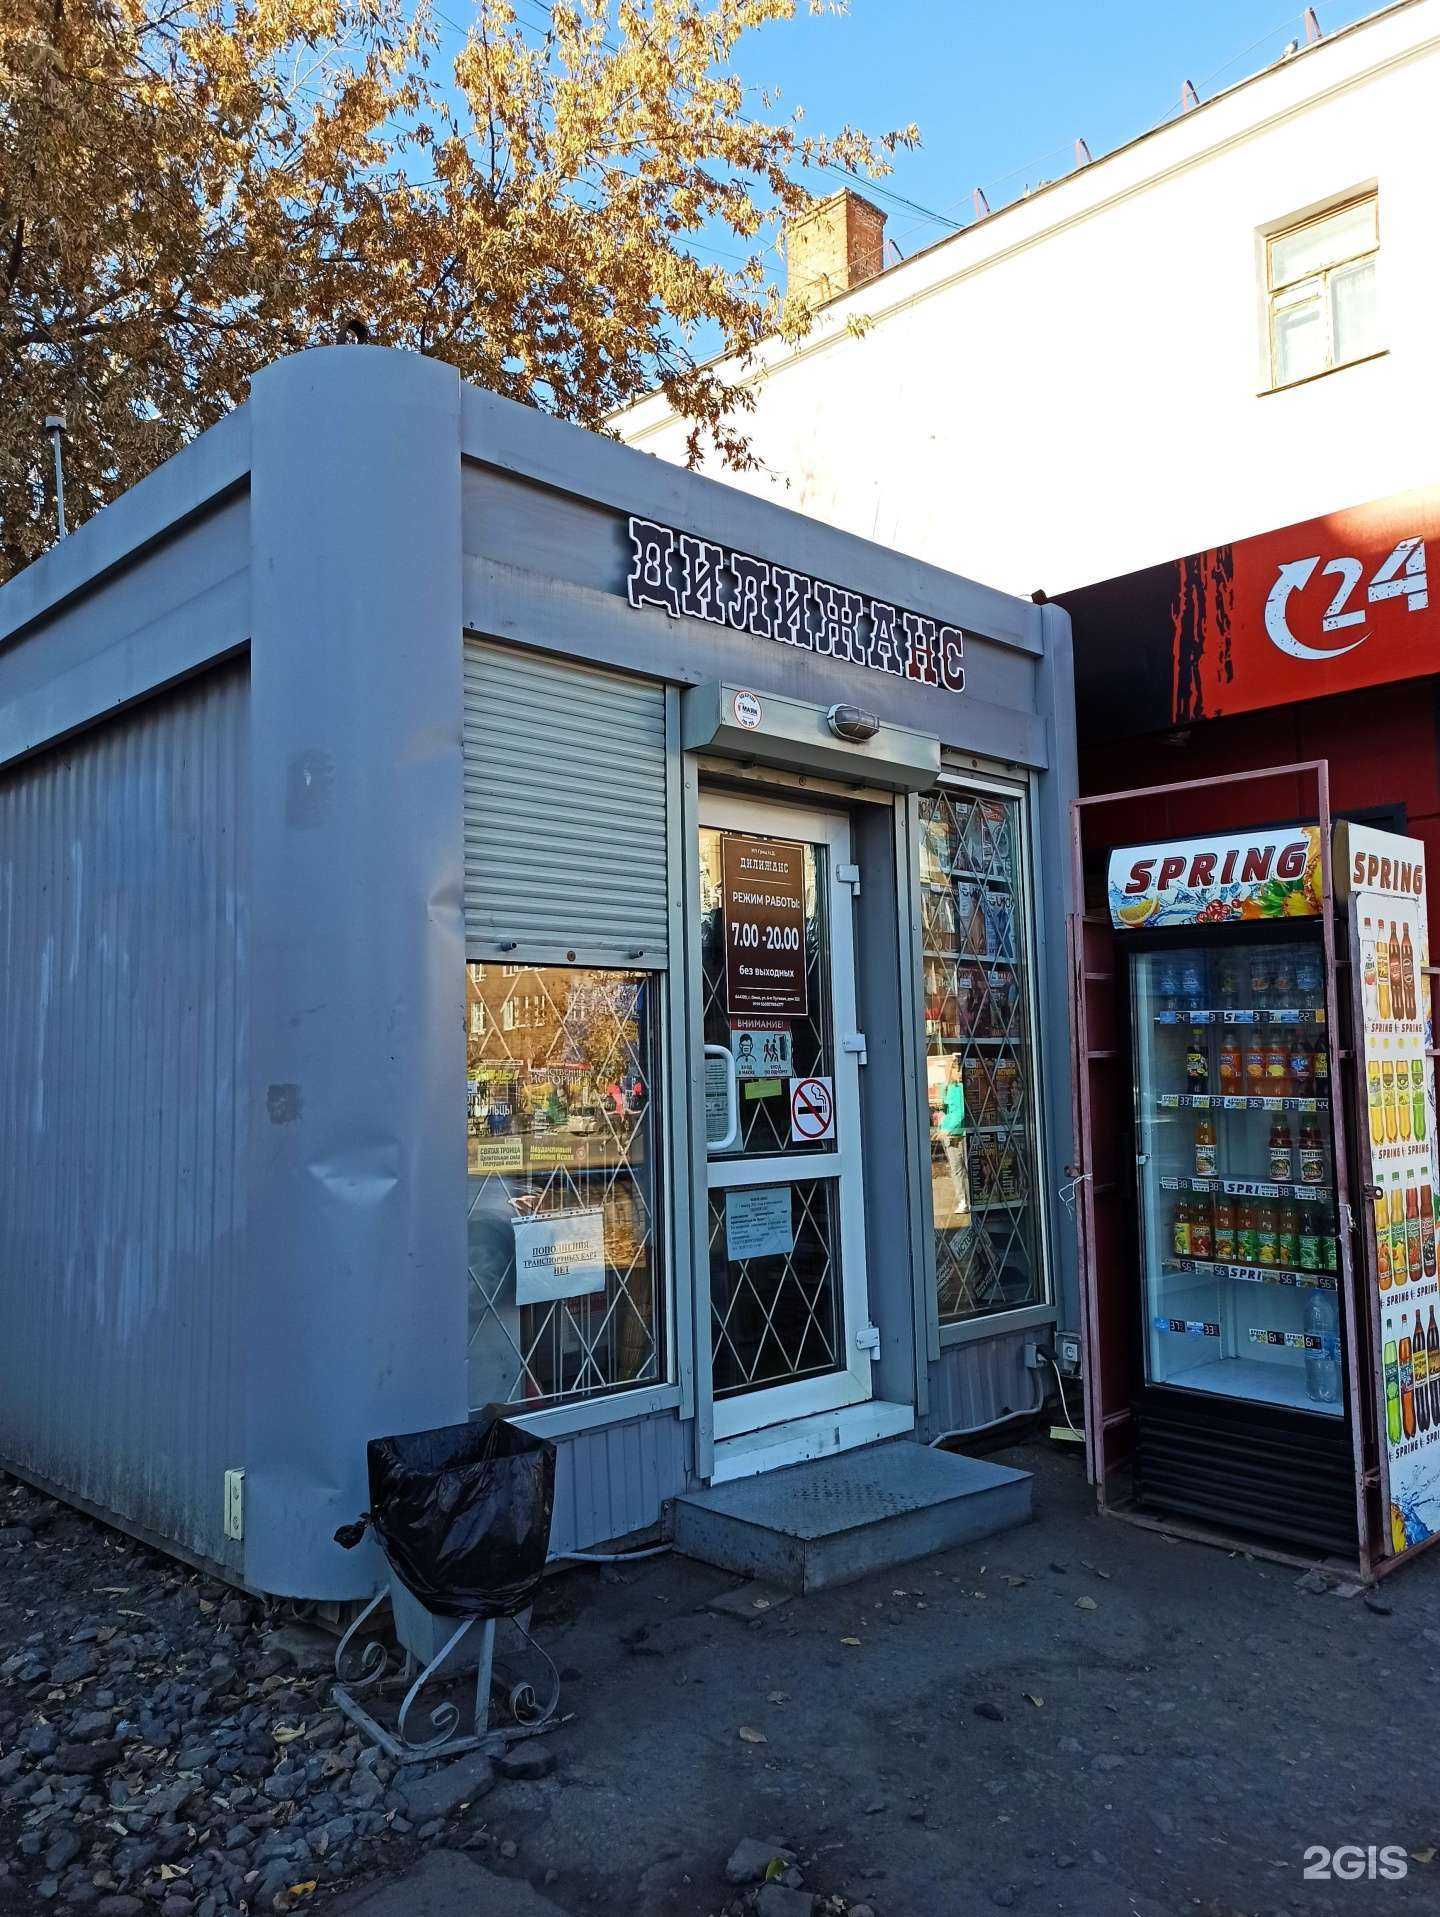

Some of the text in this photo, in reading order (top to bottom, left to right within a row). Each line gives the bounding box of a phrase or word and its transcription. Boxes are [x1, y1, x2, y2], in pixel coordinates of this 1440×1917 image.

[1321, 534, 1430, 632] 24
[628, 516, 966, 693] ДИЛИЖАНС
[740, 857, 789, 873] ДИЛИЖАНС
[1125, 841, 1310, 895] SPRING
[1353, 850, 1423, 895] SPRING
[732, 891, 801, 909] РЕЖИМ РАБОТЫ:
[731, 922, 759, 948] 7.00
[739, 964, 795, 978] без выходных
[737, 1018, 784, 1029] ВНИМАНИЕ!
[1371, 1023, 1423, 1033] SPRING SPRING
[500, 1146, 521, 1154] ТРОИЦА
[1378, 1144, 1430, 1160] SPRING SPRING
[554, 1265, 570, 1276] НЕТ
[1386, 1282, 1438, 1307] SPRING SPRING
[1395, 1441, 1419, 1460] SPRING
